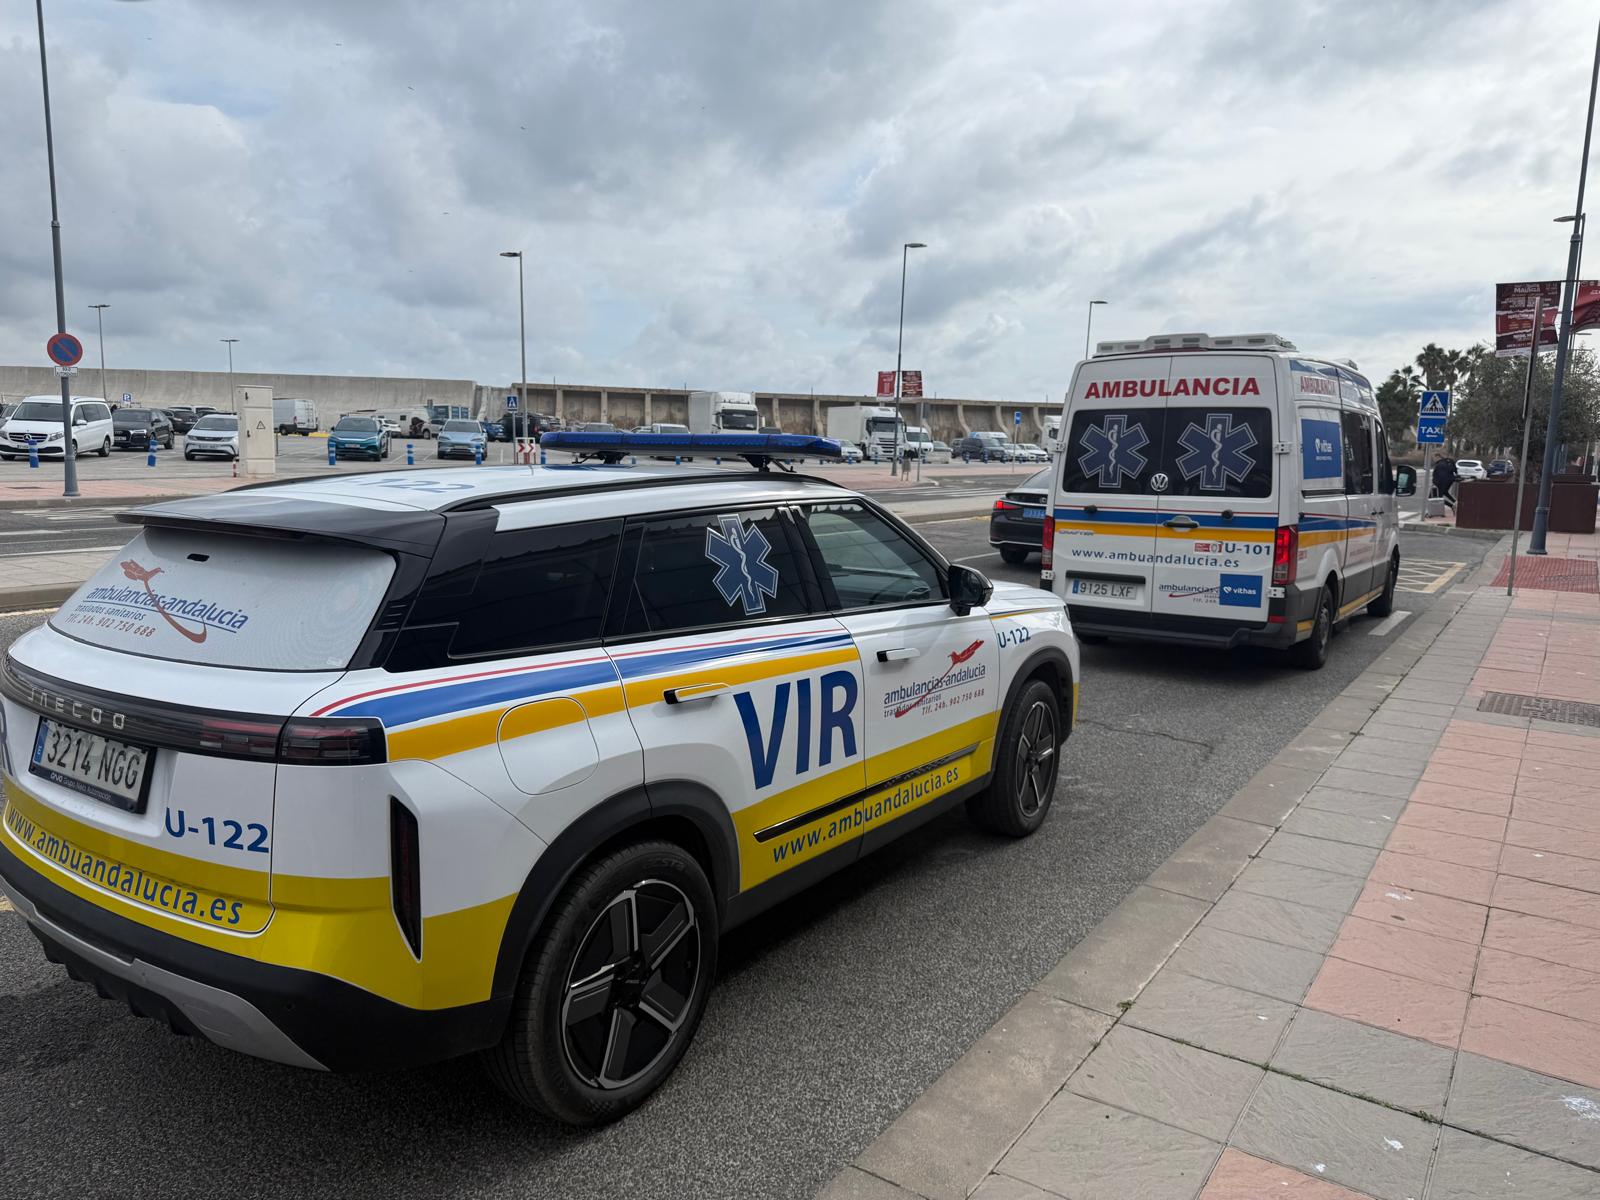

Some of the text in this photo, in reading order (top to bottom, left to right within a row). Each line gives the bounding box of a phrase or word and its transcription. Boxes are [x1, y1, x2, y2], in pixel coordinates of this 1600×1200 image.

[1085, 376, 1261, 399] AMBULANCIA
[1420, 426, 1444, 435] TAXI
[1072, 549, 1239, 568] www.ambuandalucia.es
[1225, 543, 1271, 556] U-101
[1080, 582, 1134, 598] 9125 LXF
[1232, 587, 1256, 596] vithas
[86, 585, 249, 630] ambulancias-andalucia
[106, 606, 147, 621] sanitarios
[96, 617, 112, 628] 902
[116, 620, 131, 632] 750
[134, 625, 156, 638] 688
[997, 626, 1031, 649] U-122
[884, 663, 986, 705] ambulancias-andalucia
[733, 670, 858, 790] VIR
[47, 730, 94, 775] 3214
[97, 747, 140, 789] NGG
[773, 765, 960, 864] www.ambuandalucia.es
[165, 807, 270, 853] U-122
[8, 807, 244, 925] www.ambuandalucia.es
